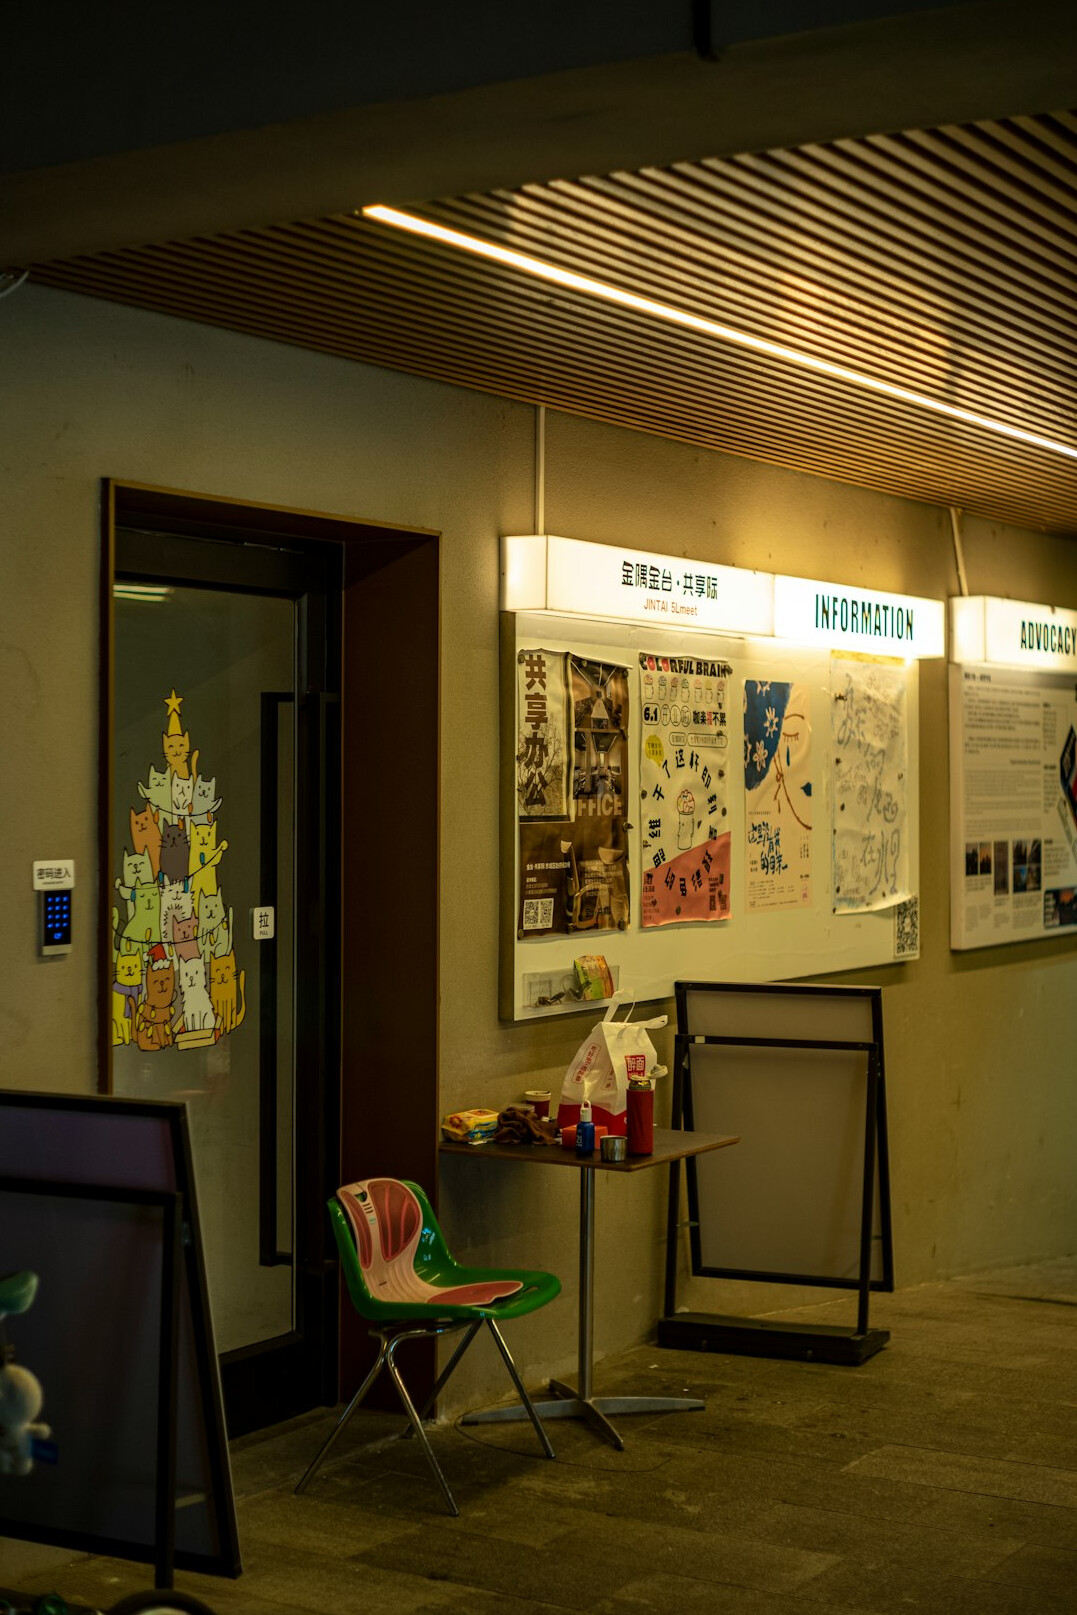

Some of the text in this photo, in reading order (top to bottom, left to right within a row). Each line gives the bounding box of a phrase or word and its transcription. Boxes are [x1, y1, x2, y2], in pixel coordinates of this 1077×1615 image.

[643, 598, 668, 613] JINTAI
[815, 594, 915, 641] INFORMATION
[1020, 620, 1077, 656] ADVOCACY
[643, 707, 658, 721] 6.1
[523, 654, 549, 807] 共享办公
[573, 793, 623, 817] FFICE
[37, 867, 71, 880] 密码进入
[259, 912, 269, 928] 拉
